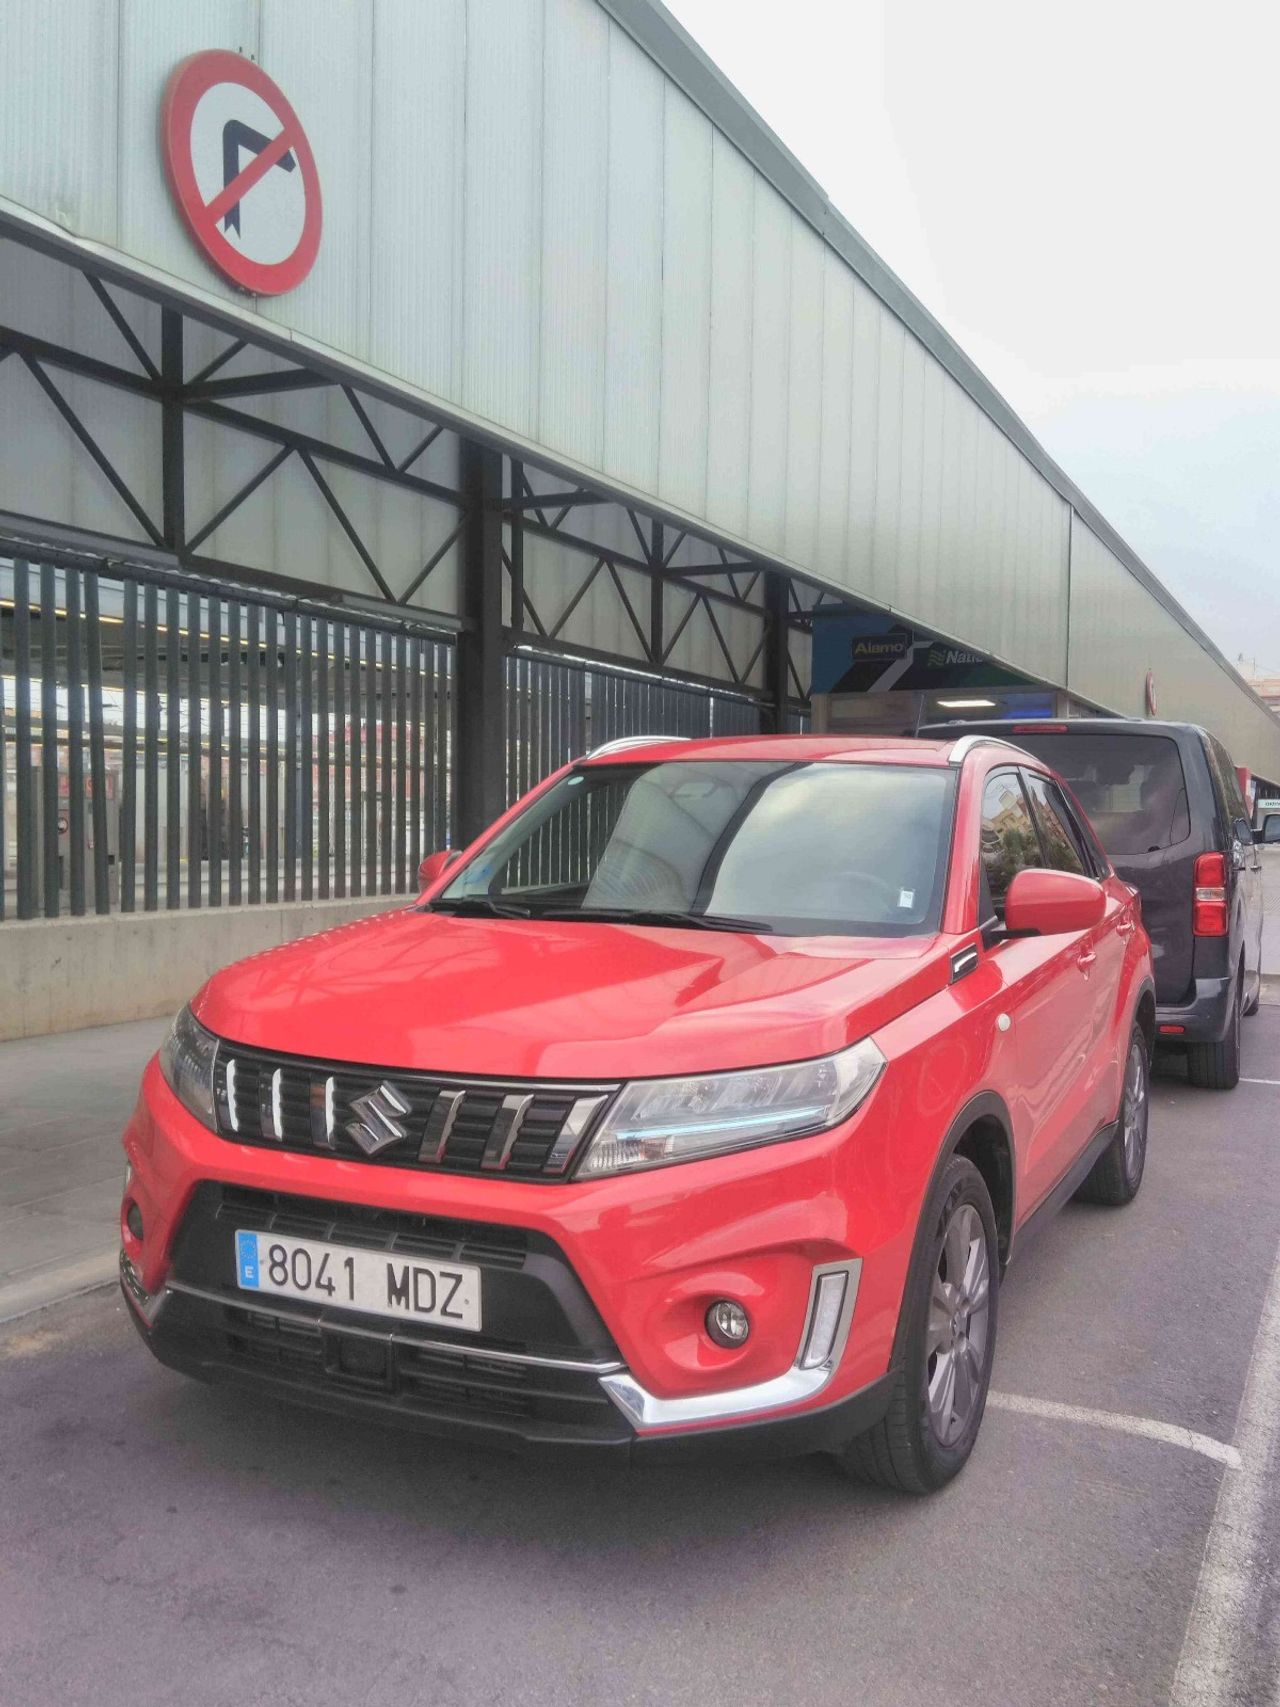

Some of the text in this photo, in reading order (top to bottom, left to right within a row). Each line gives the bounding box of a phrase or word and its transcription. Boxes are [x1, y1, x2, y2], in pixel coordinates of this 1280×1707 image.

[855, 641, 903, 655] Alamo
[245, 1265, 254, 1278] E
[268, 1244, 464, 1319] 8041 MDZ
